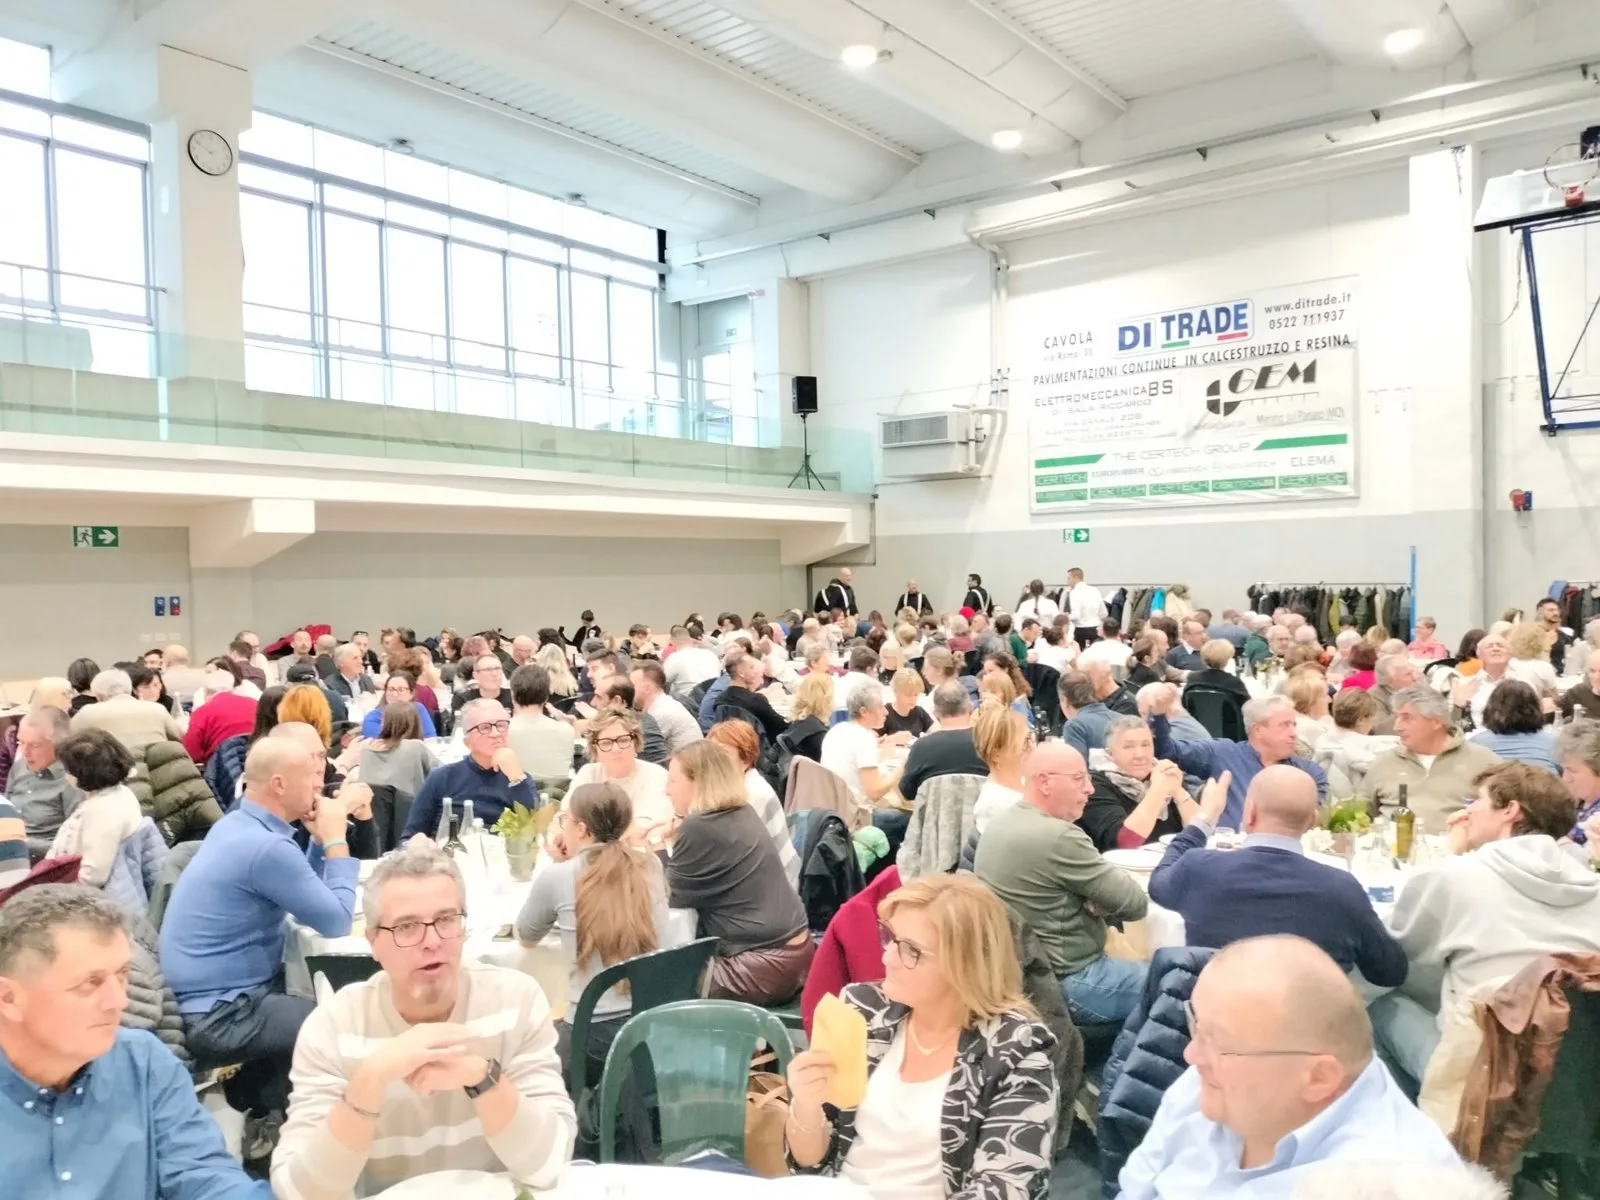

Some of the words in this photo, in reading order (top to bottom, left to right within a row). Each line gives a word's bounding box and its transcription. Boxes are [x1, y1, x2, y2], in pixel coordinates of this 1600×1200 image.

[1264, 292, 1351, 314] www.ditrade.it
[1118, 322, 1152, 351] DI
[1160, 303, 1248, 341] TRADE
[1269, 316, 1297, 330] 0522
[1303, 309, 1345, 326] 711937
[1044, 331, 1093, 349] CAVOLA
[1033, 365, 1118, 385] PAVIMENTAZIONI
[1122, 357, 1177, 375] CONTINUE
[1185, 354, 1197, 367] IN
[1202, 341, 1290, 363] CALCESTRUZZO
[1295, 340, 1301, 351] E
[1306, 334, 1351, 351] RESINA
[1228, 358, 1317, 394] GEM
[1035, 386, 1148, 407] ELETTROMECCANICA
[1148, 379, 1173, 397] BS
[1112, 452, 1136, 462] THE
[1203, 442, 1251, 455] GROUP
[1291, 454, 1336, 467] ELEMA
